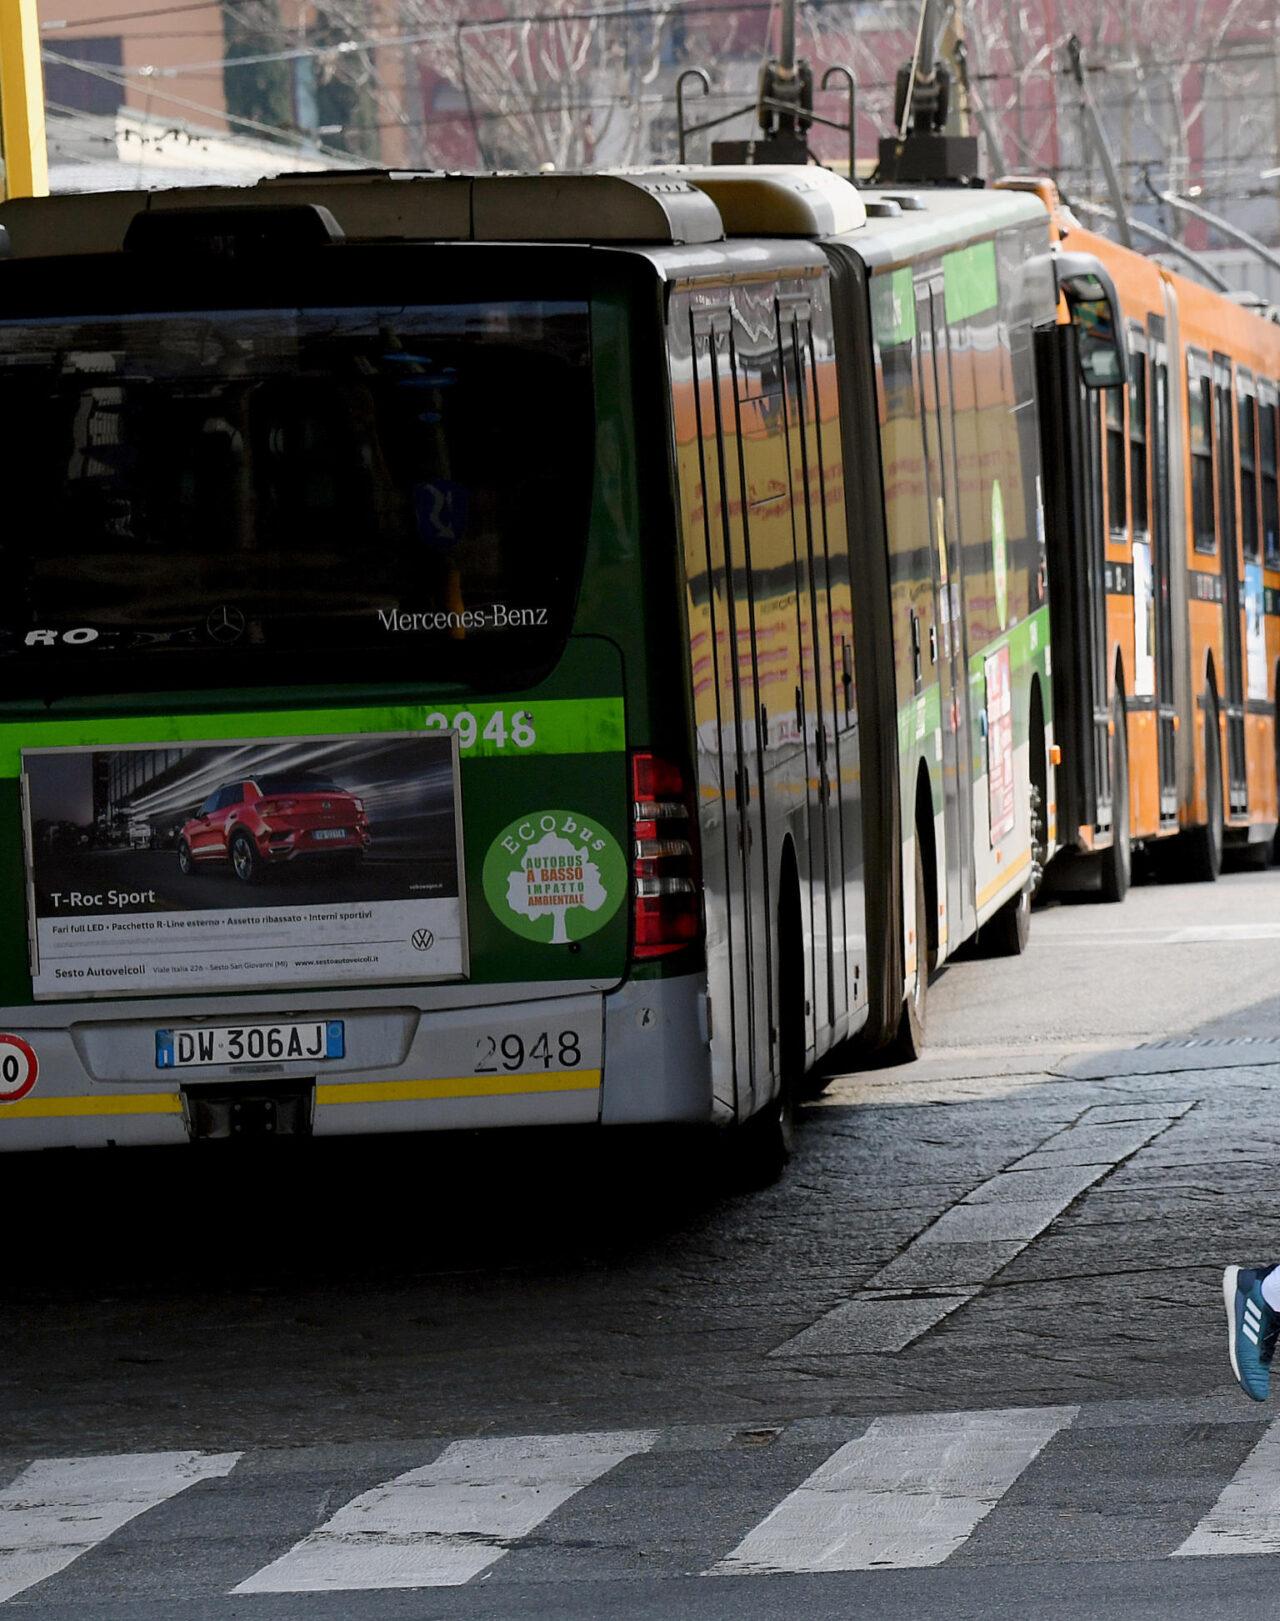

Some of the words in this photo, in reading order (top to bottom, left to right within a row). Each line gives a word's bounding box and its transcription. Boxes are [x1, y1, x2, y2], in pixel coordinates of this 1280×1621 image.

[501, 815, 606, 855] ECObus
[526, 855, 583, 869] AUTOBUS
[527, 869, 535, 883] A
[541, 867, 583, 882] BASSO
[527, 882, 585, 895] IMPATTO
[50, 892, 103, 908] T-Roc
[107, 889, 156, 908] Sport
[528, 894, 585, 906] AMBIENTALE
[52, 925, 69, 934] Fari
[71, 924, 85, 933] full
[87, 923, 104, 932] LED
[111, 921, 155, 931] Pacchetto
[157, 919, 185, 929] R-Line
[187, 918, 220, 927] esterno
[227, 916, 261, 926] Assetto
[262, 914, 302, 924] ribassato
[309, 912, 338, 922] Interni
[340, 910, 373, 921] sportivi
[152, 965, 170, 974] Viale
[171, 964, 189, 973] Italia
[209, 963, 230, 972] Sesto
[231, 962, 245, 971] San
[245, 960, 274, 970] Giovanni
[294, 955, 379, 967] www.sestoautoveicoli.it
[55, 967, 85, 979] Sesto
[87, 964, 146, 977] Autoveicoli
[178, 1031, 214, 1063] DW
[227, 1025, 323, 1060] 306AJ
[474, 1030, 582, 1073] 2948
[0, 1055, 19, 1083] 0
